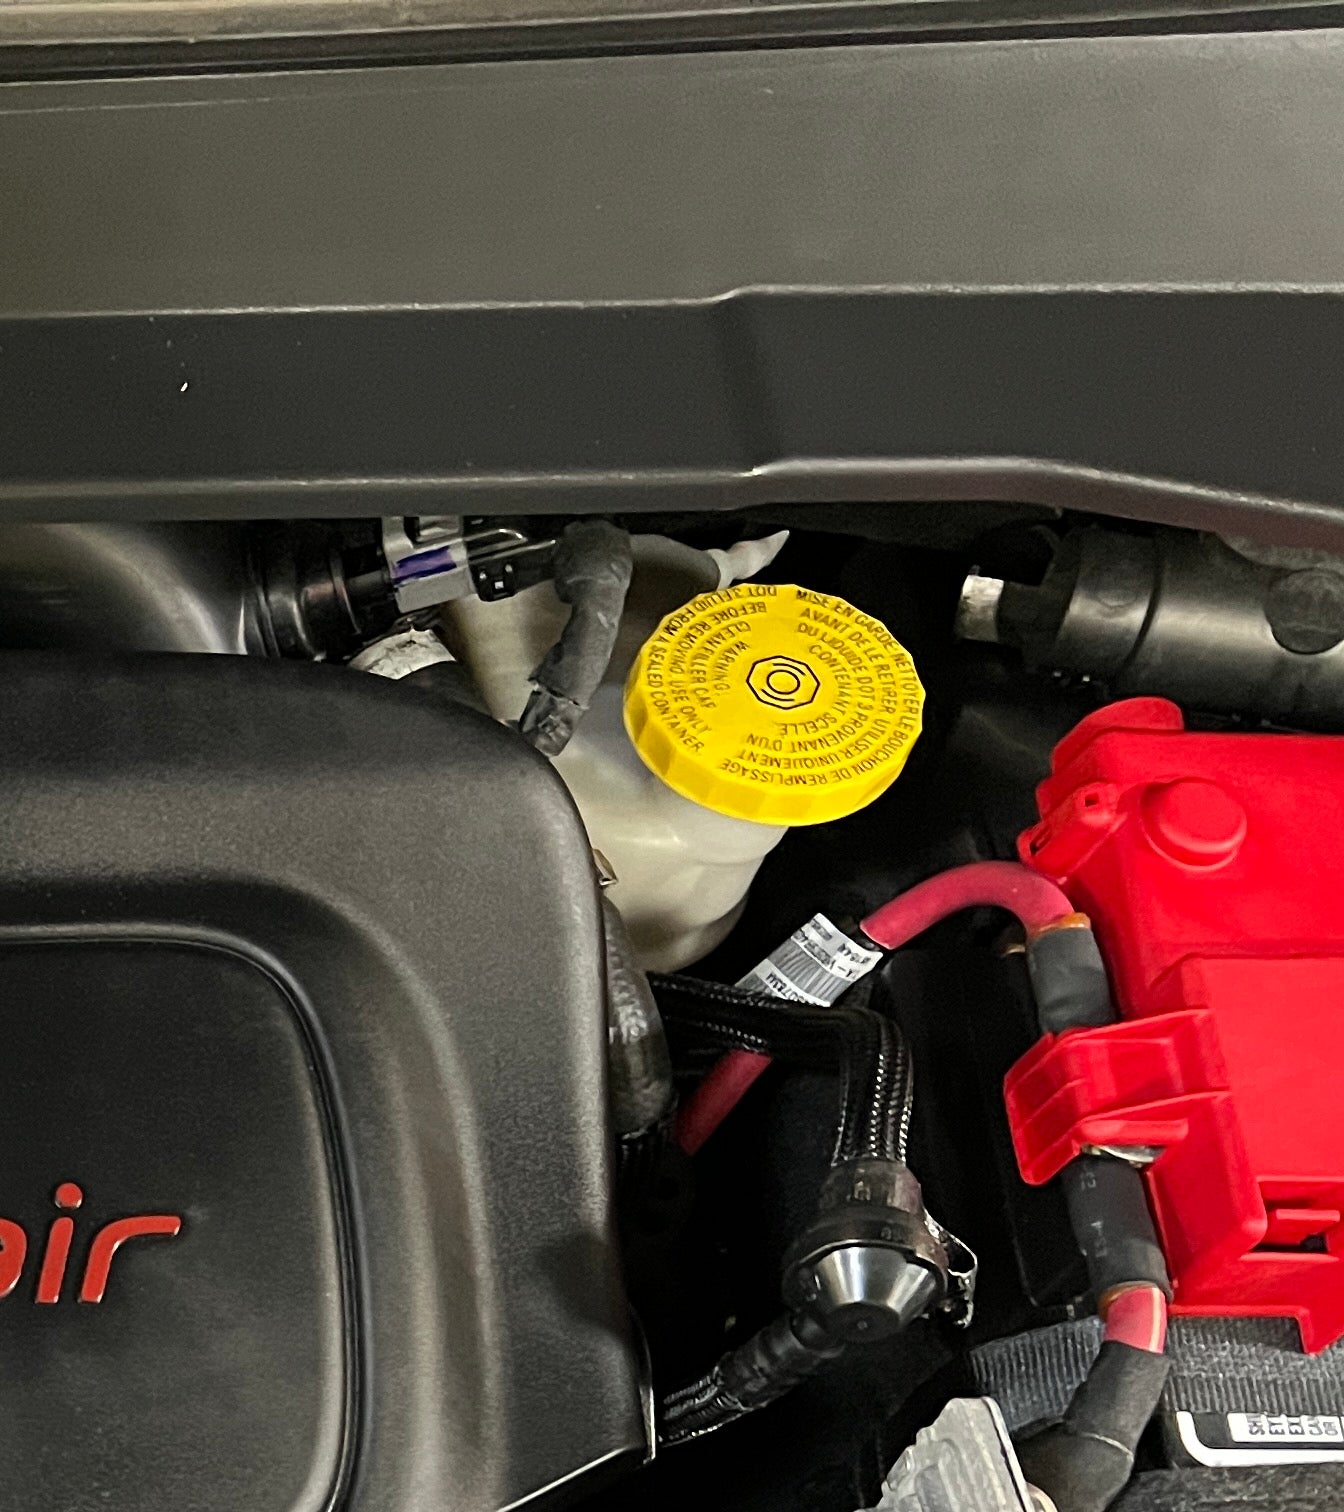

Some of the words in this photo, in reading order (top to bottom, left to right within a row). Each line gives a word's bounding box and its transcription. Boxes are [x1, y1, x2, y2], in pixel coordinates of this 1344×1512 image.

[692, 590, 733, 612] FLUID
[748, 586, 777, 597] DOT
[796, 589, 830, 608] MISE
[662, 607, 697, 637] FROM
[709, 601, 768, 626] BEFORE
[799, 607, 850, 633] AVANT
[833, 602, 855, 617] EN
[706, 620, 752, 649] CLEAN
[848, 631, 871, 648] DE
[646, 645, 667, 688] SEALED
[689, 645, 715, 683] FILLER
[863, 646, 884, 663] LE
[668, 680, 690, 703] USE
[809, 645, 852, 715] CONTENANT
[856, 677, 875, 700] DOT
[891, 653, 919, 714] NETTOYER
[679, 705, 712, 734] ONLY
[791, 712, 869, 752] PROVENANT
[898, 715, 917, 731] LE
[839, 718, 891, 759] UTILISER
[737, 748, 841, 770] UNIQUEMENT
[851, 730, 909, 775] BOUCHON
[719, 758, 828, 786] REMPLISSAGE
[830, 767, 852, 781] DE
